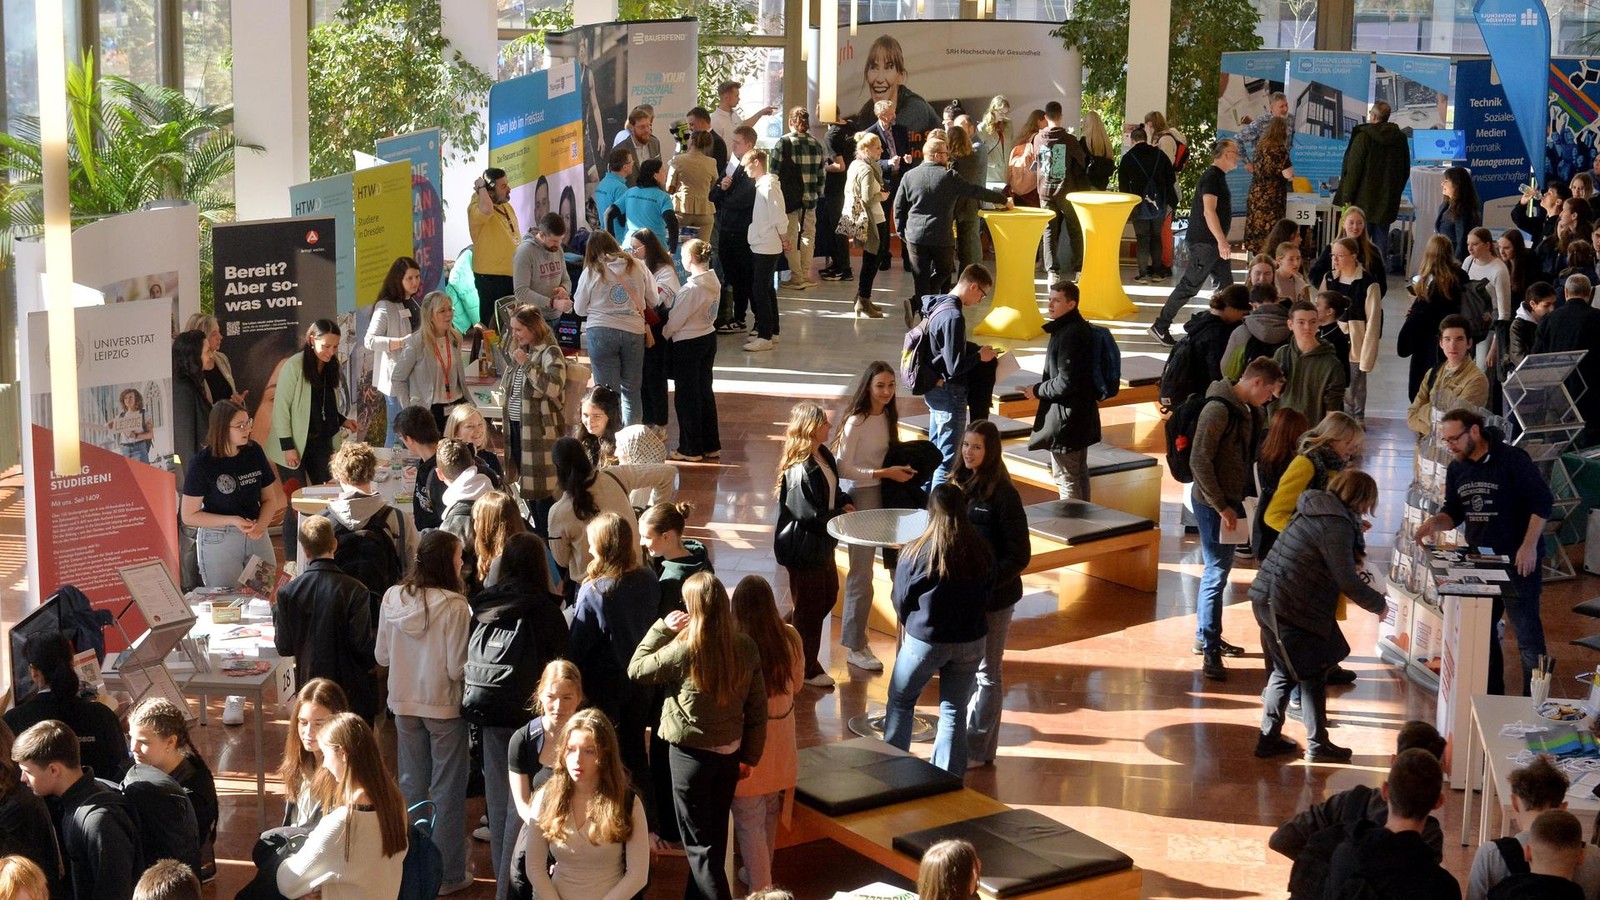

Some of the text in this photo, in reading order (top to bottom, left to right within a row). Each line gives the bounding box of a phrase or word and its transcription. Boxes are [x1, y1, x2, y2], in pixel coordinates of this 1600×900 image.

[645, 33, 687, 42] BAUERFEIND
[1007, 49, 1041, 57] Gesundheit
[1469, 97, 1503, 108] Technik
[1484, 112, 1515, 122] Soziales
[496, 120, 509, 135] Dein
[1475, 128, 1507, 138] Medien
[1465, 142, 1502, 153] nformatik
[1471, 157, 1525, 169] Management
[358, 214, 380, 227] Studiere
[1295, 210, 1310, 220] 35
[363, 225, 385, 238] Dresden
[224, 262, 287, 280] Bereit?
[224, 280, 299, 296] Aber so-
[224, 296, 303, 312] was von.
[94, 333, 156, 350] UNIVERSITÄT
[94, 348, 130, 361] LEIPZIG
[50, 472, 112, 490] STUDIEREN!
[74, 496, 85, 504] Seit
[85, 493, 102, 502] 1409.
